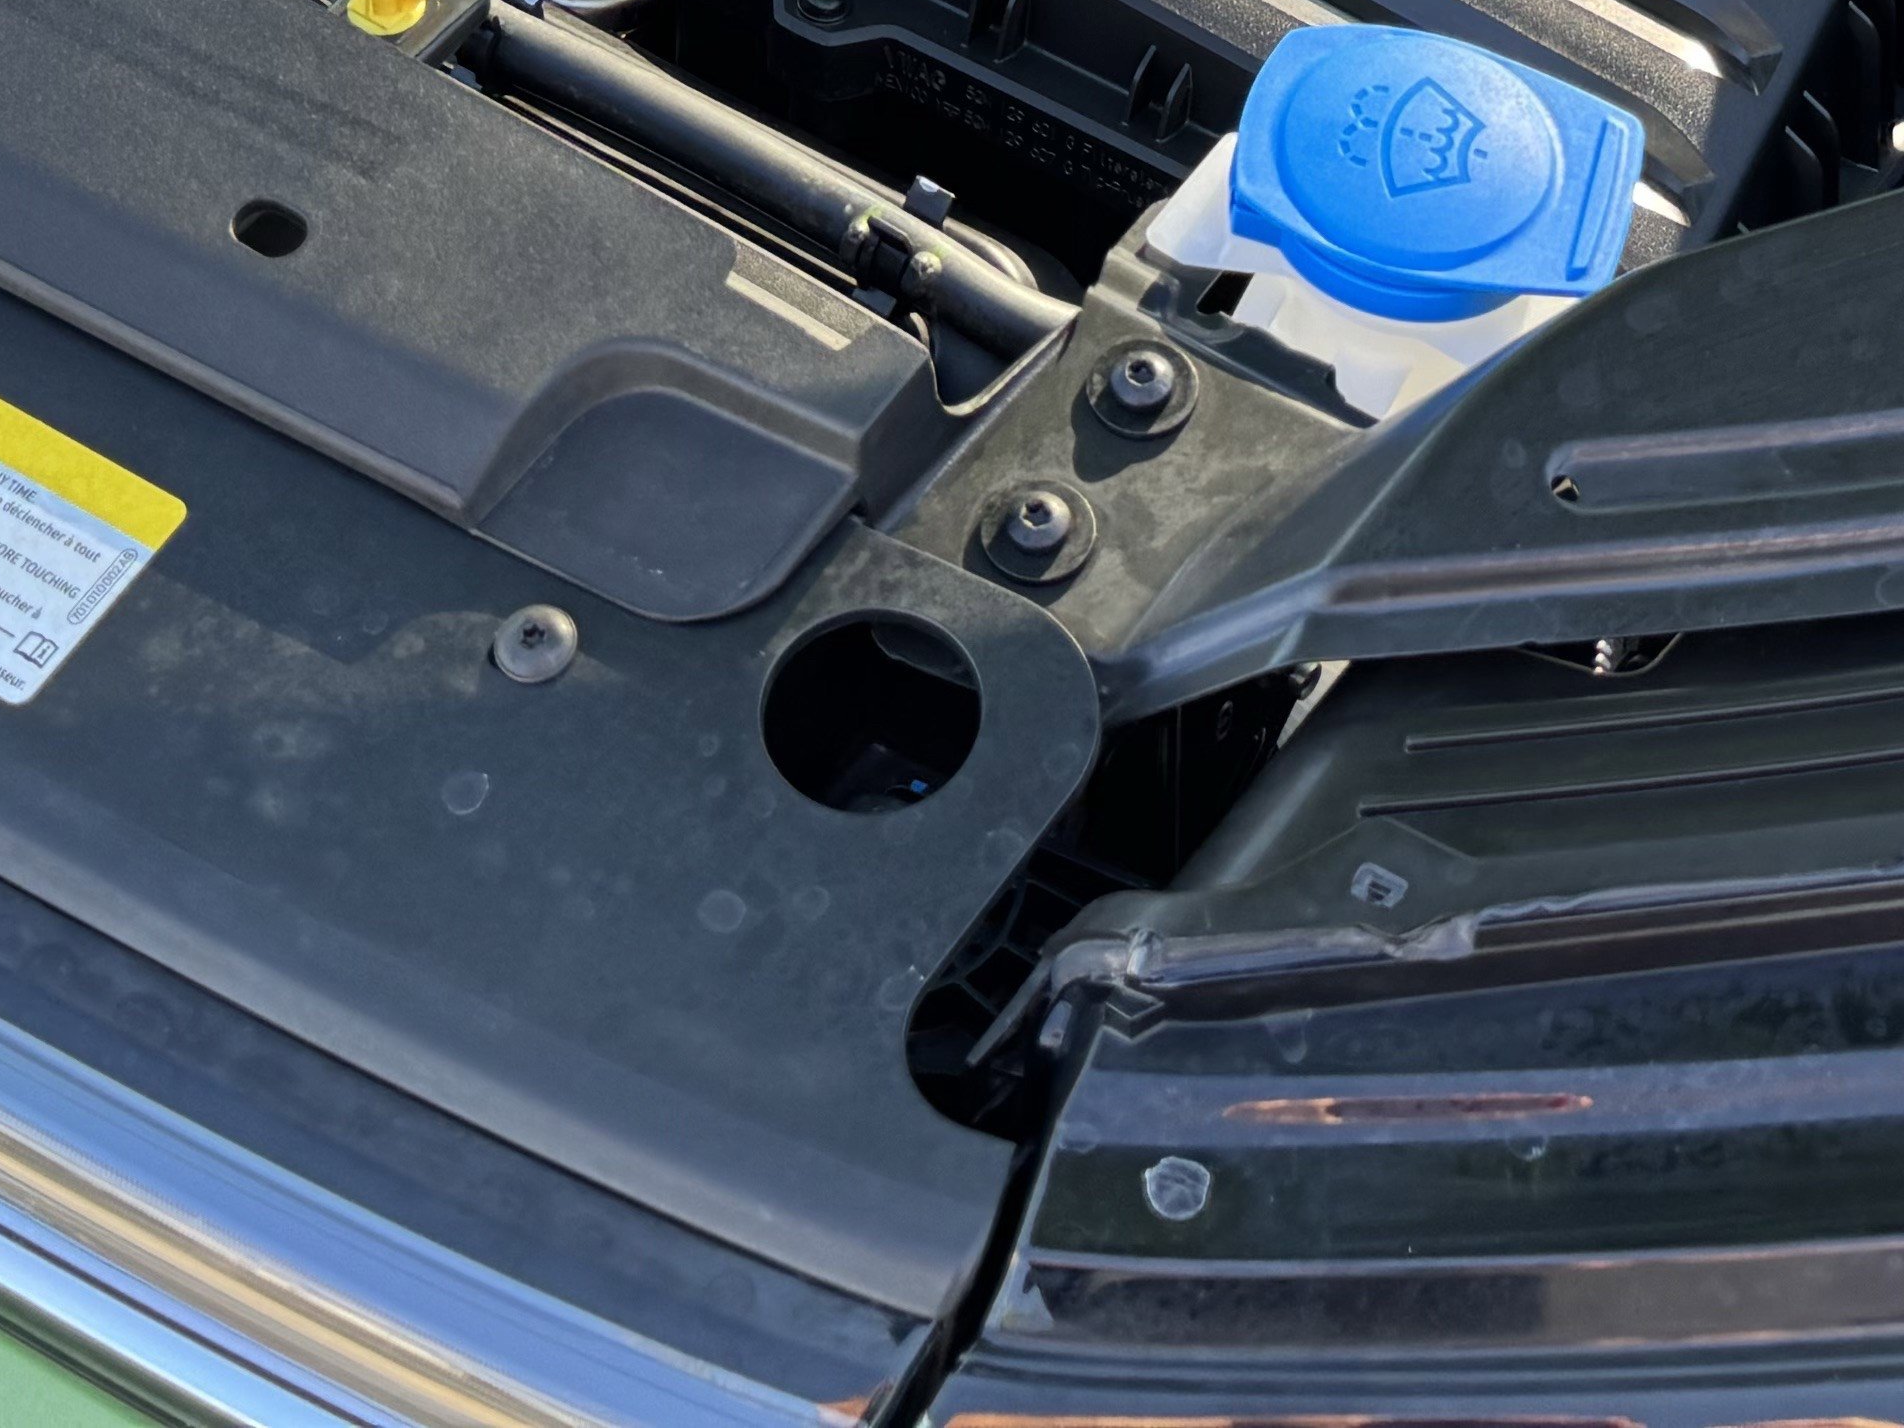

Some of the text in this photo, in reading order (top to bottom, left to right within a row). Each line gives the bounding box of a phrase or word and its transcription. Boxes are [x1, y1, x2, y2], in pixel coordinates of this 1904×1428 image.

[7, 478, 38, 504] TIME.
[1, 500, 65, 541] déclencher
[62, 533, 75, 548] à
[72, 541, 101, 563] tout
[19, 556, 81, 599] TOUCHING
